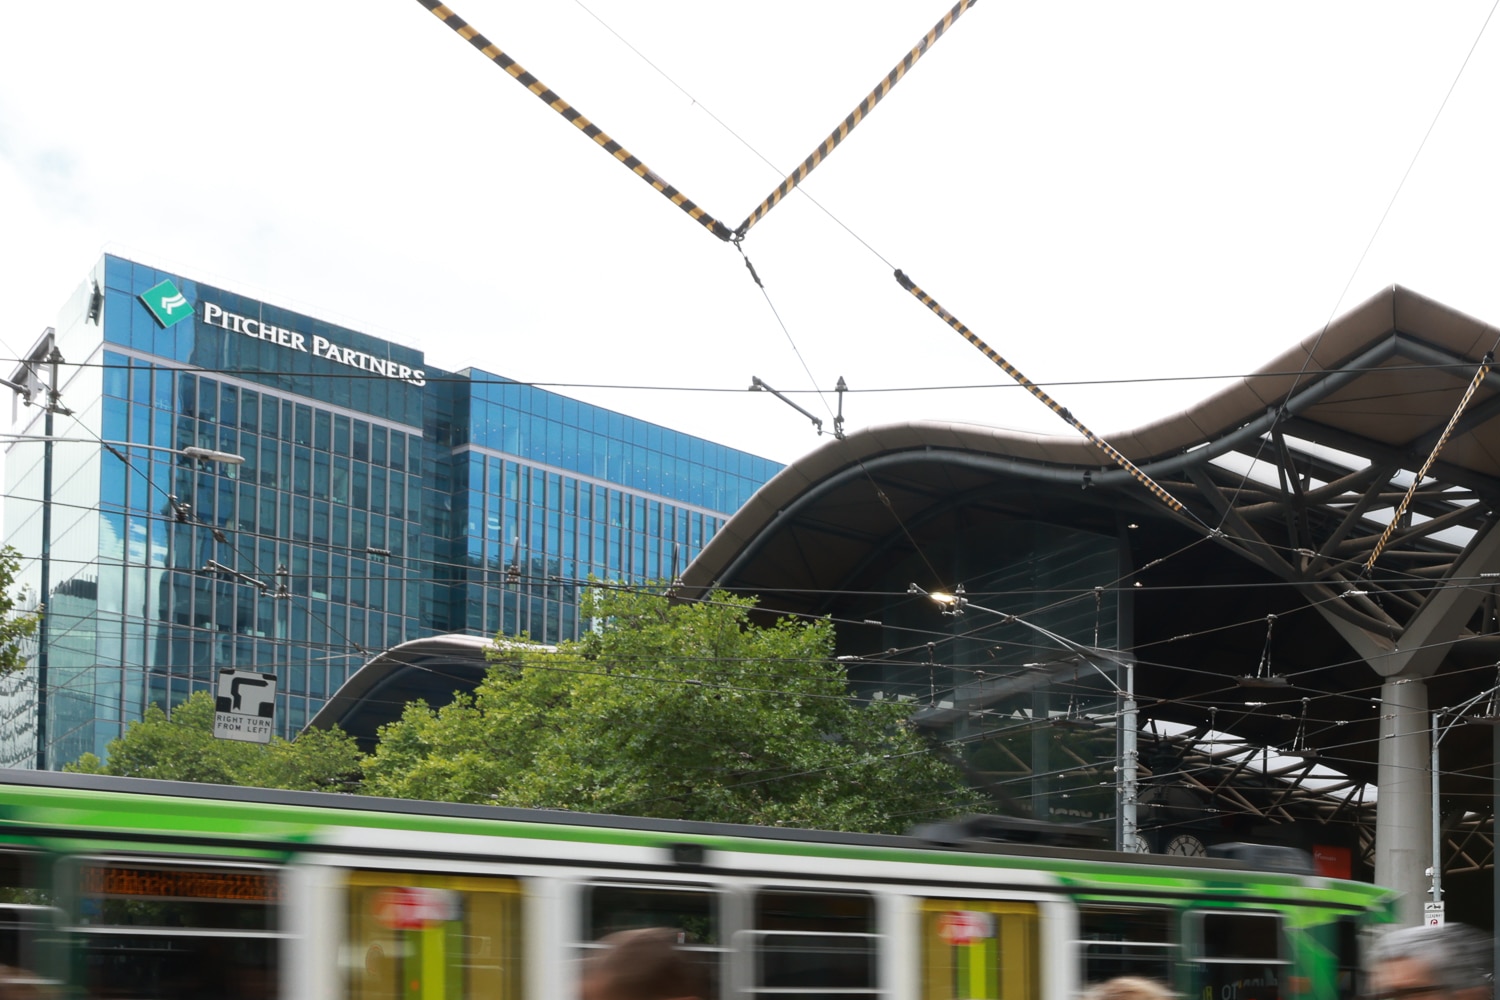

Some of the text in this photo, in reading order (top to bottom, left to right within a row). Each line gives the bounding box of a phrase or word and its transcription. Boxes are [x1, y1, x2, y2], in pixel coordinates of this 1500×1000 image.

[203, 301, 427, 387] PITCHER PARTNERS
[217, 715, 271, 727] RIGHT TURN
[217, 723, 241, 731] FROM
